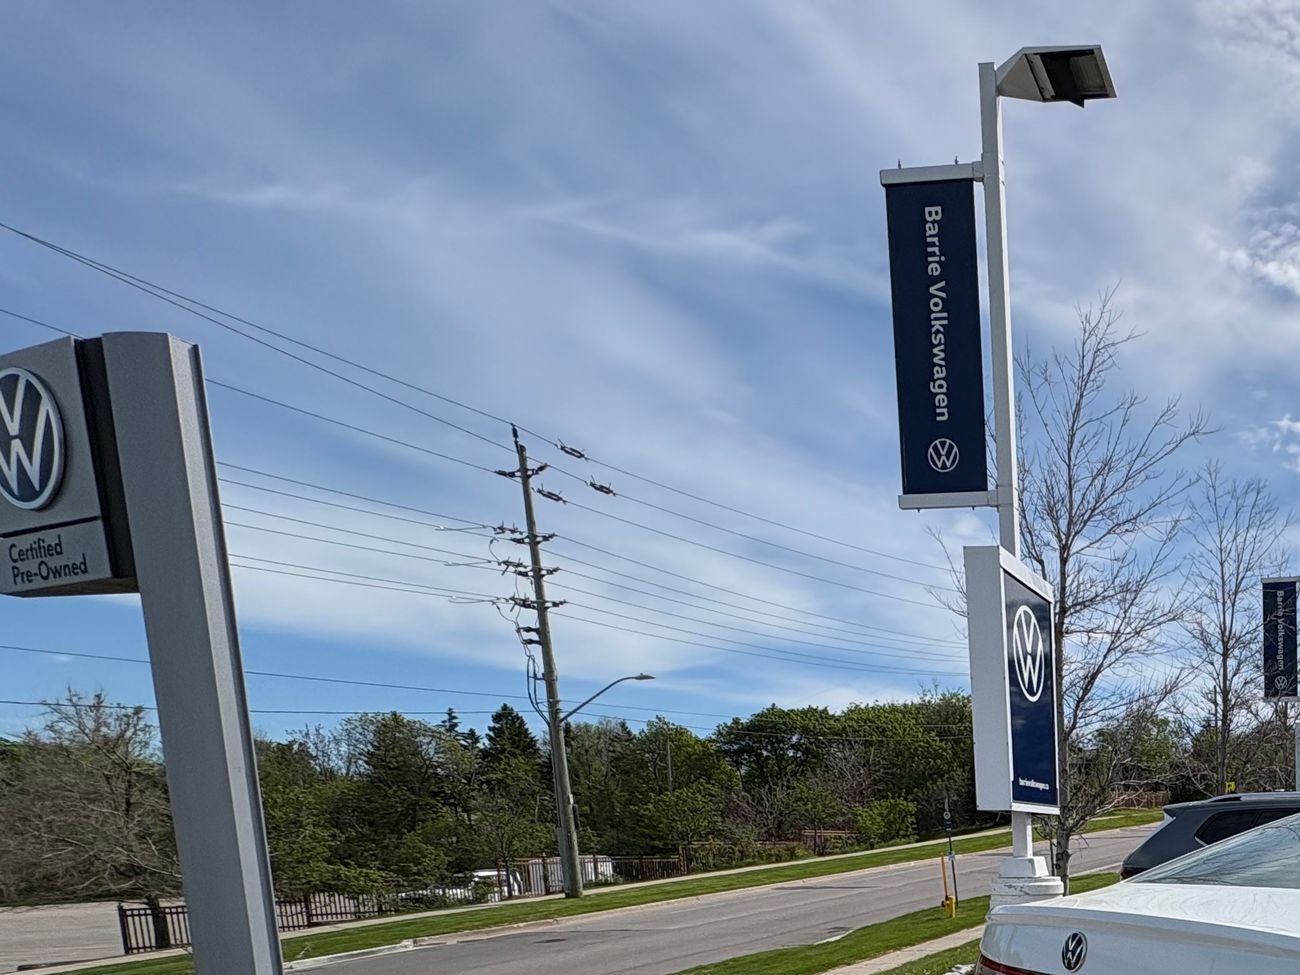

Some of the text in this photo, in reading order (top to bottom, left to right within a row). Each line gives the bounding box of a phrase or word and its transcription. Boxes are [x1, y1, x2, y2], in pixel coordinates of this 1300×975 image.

[924, 205, 949, 422] Barrie Volkswagen
[9, 534, 64, 563] Certified
[11, 553, 88, 585] Pre-Owned
